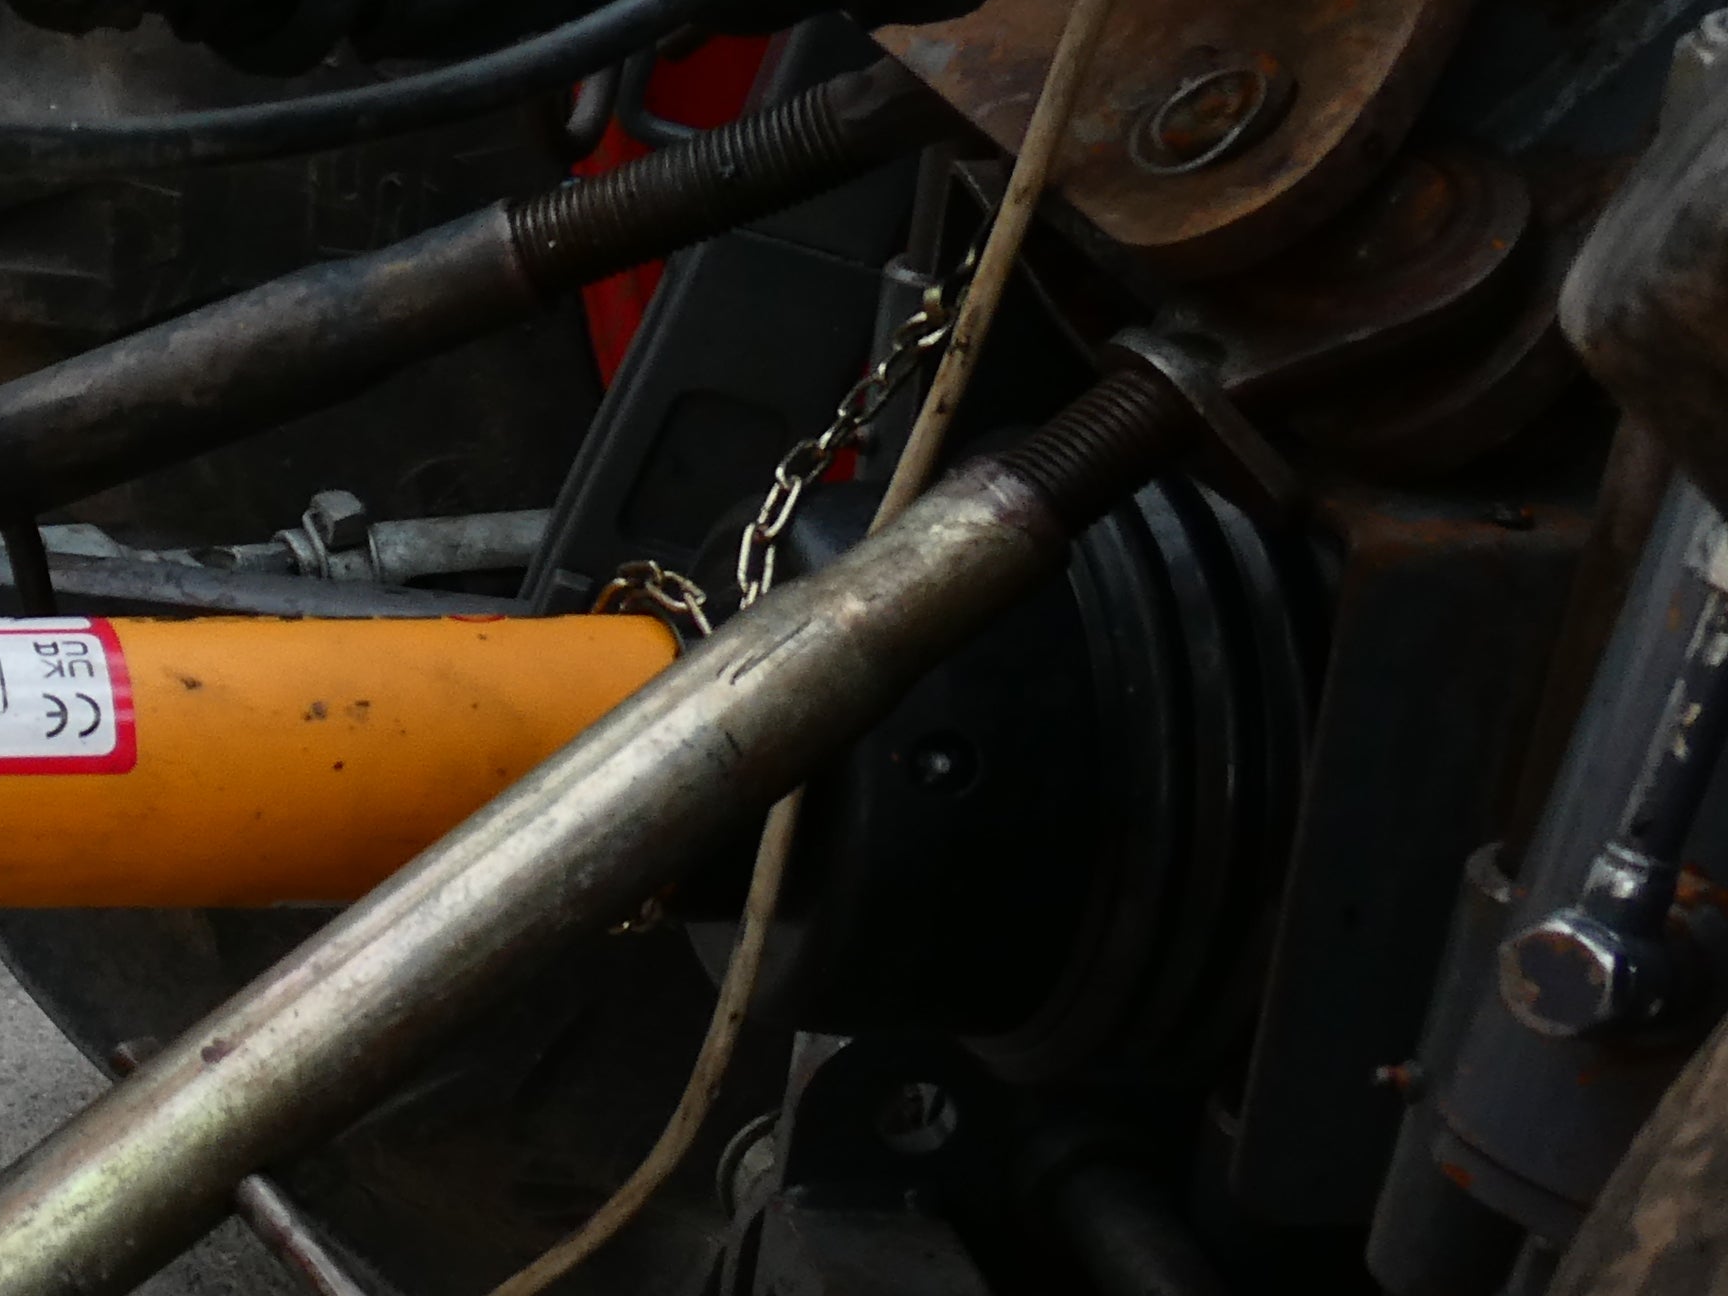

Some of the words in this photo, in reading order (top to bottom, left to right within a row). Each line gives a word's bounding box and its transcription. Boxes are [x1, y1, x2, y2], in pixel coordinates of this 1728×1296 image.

[33, 640, 89, 656] CA
[42, 658, 95, 678] UK
[42, 692, 102, 738] CE
